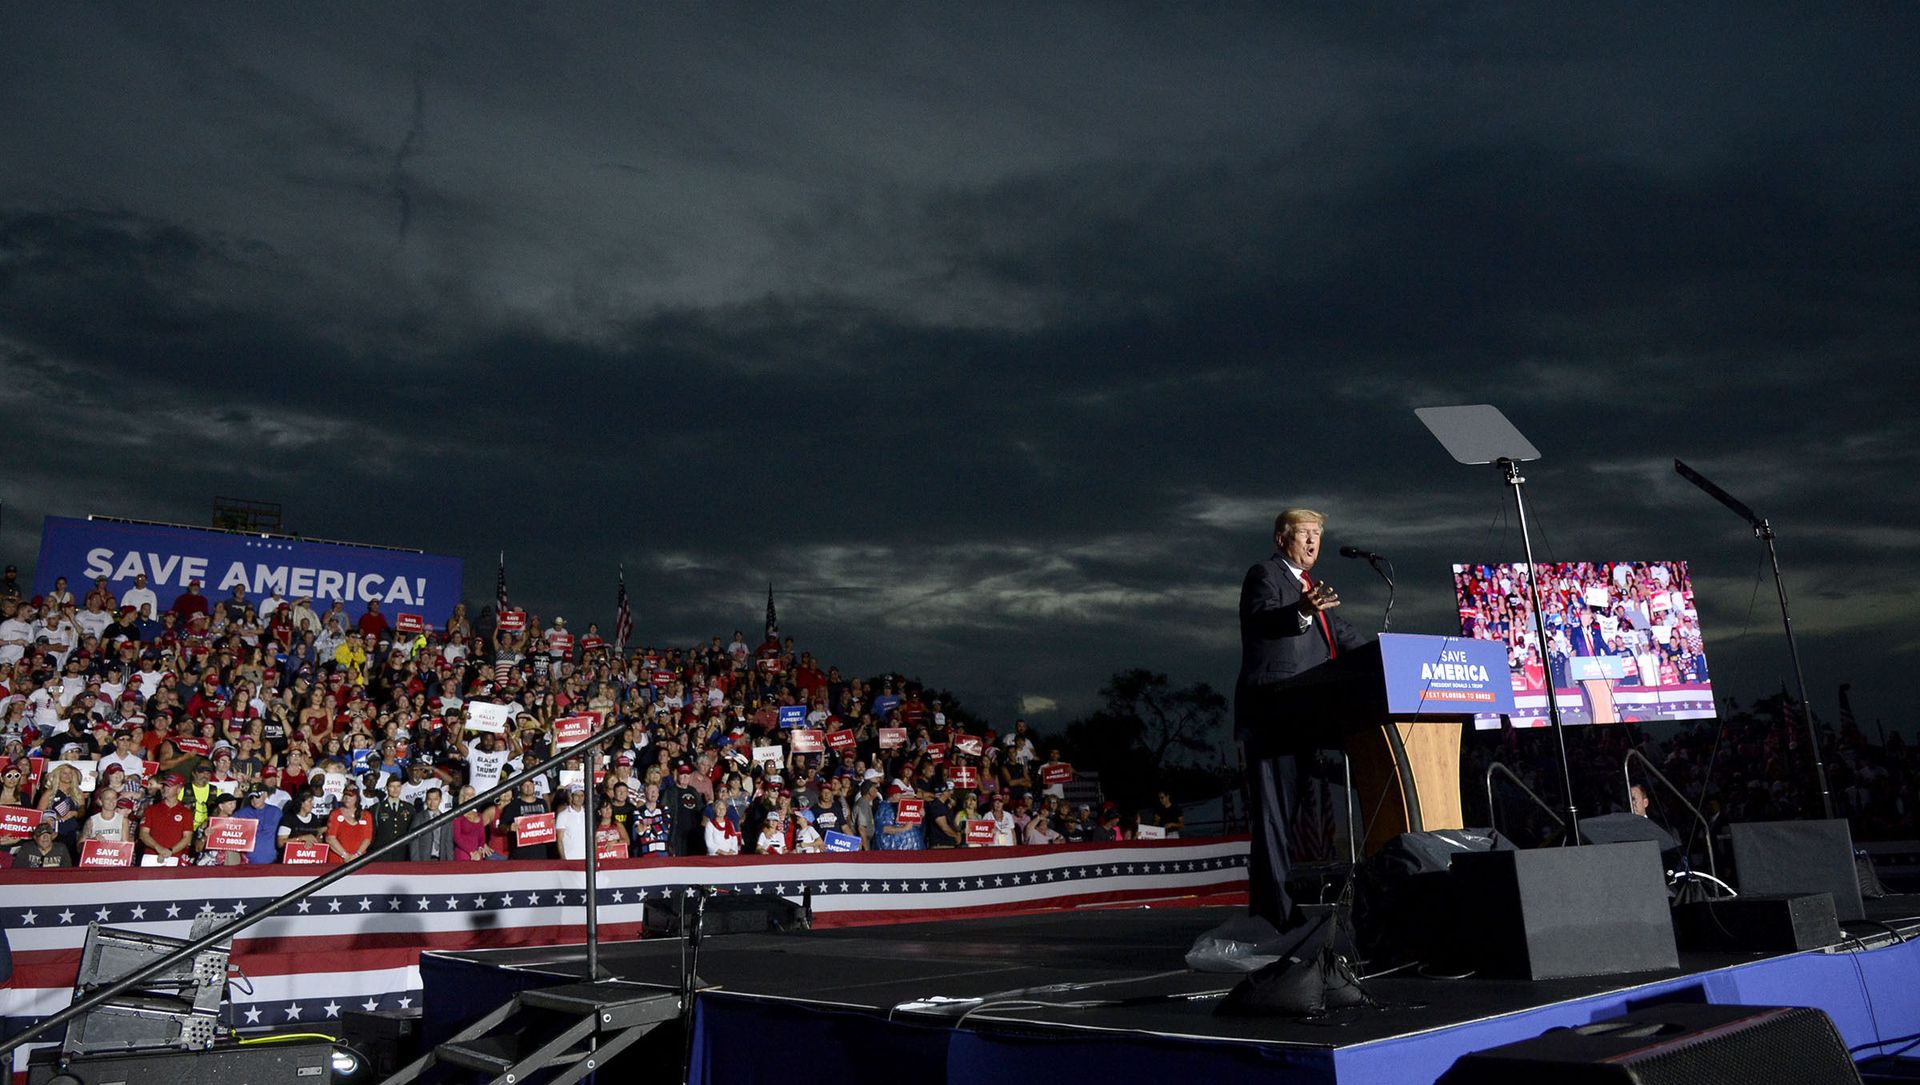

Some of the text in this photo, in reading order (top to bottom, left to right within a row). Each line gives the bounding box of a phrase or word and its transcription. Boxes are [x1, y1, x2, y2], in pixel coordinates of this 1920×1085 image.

[83, 547, 427, 606] SAVE AMERICA!
[1441, 650, 1467, 663] SAVE
[1421, 663, 1490, 682] AMERICA
[564, 722, 581, 730] SAVE
[559, 728, 588, 738] AMERICA!
[830, 739, 853, 748] AMERICA!
[1046, 772, 1070, 780] AMERICA!
[5, 814, 28, 824] SAVE
[0, 823, 37, 833] MERICA!
[225, 823, 242, 831] TEXT
[526, 822, 545, 830] SAVE
[520, 828, 553, 840] AMERICA!
[834, 839, 851, 848] SAVE
[96, 848, 119, 857] SAVE
[296, 850, 317, 858] SAVE
[598, 850, 617, 860] SAVE
[84, 856, 127, 867] AMERICA!
